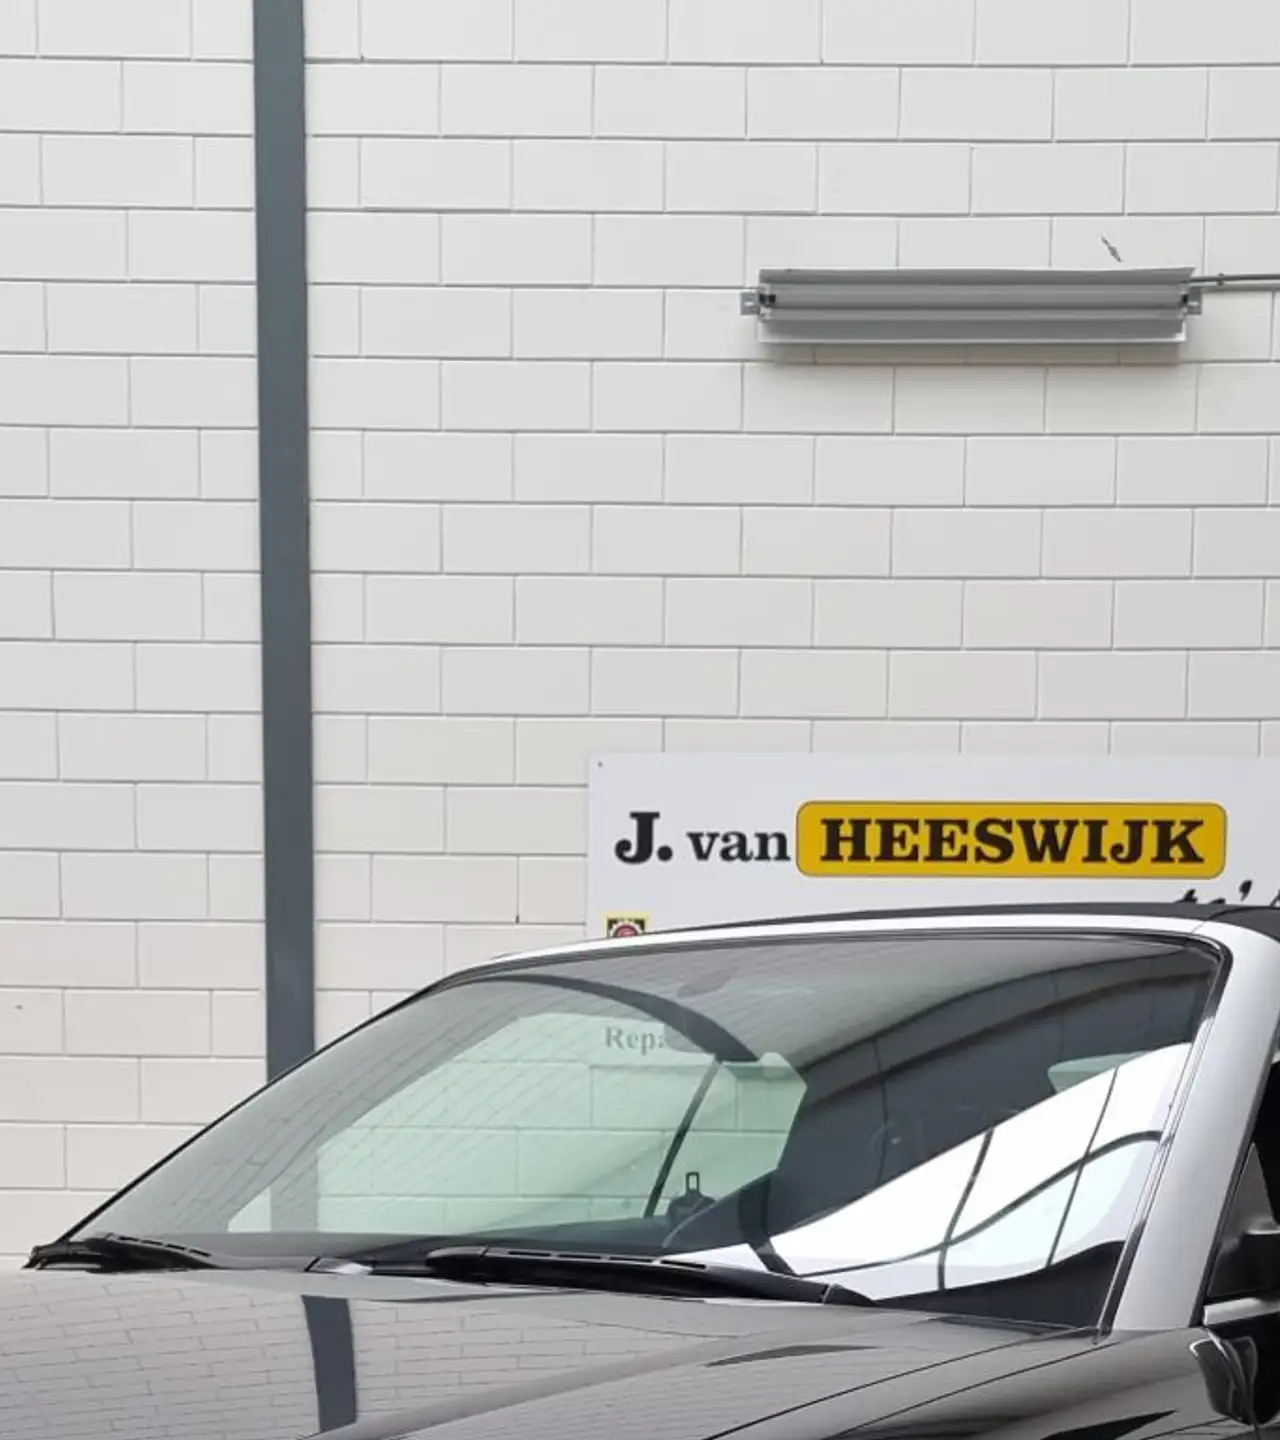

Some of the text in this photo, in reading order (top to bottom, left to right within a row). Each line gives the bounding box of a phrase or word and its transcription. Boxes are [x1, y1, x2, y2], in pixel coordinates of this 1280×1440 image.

[614, 811, 1205, 864] J. van HEESWIJK
